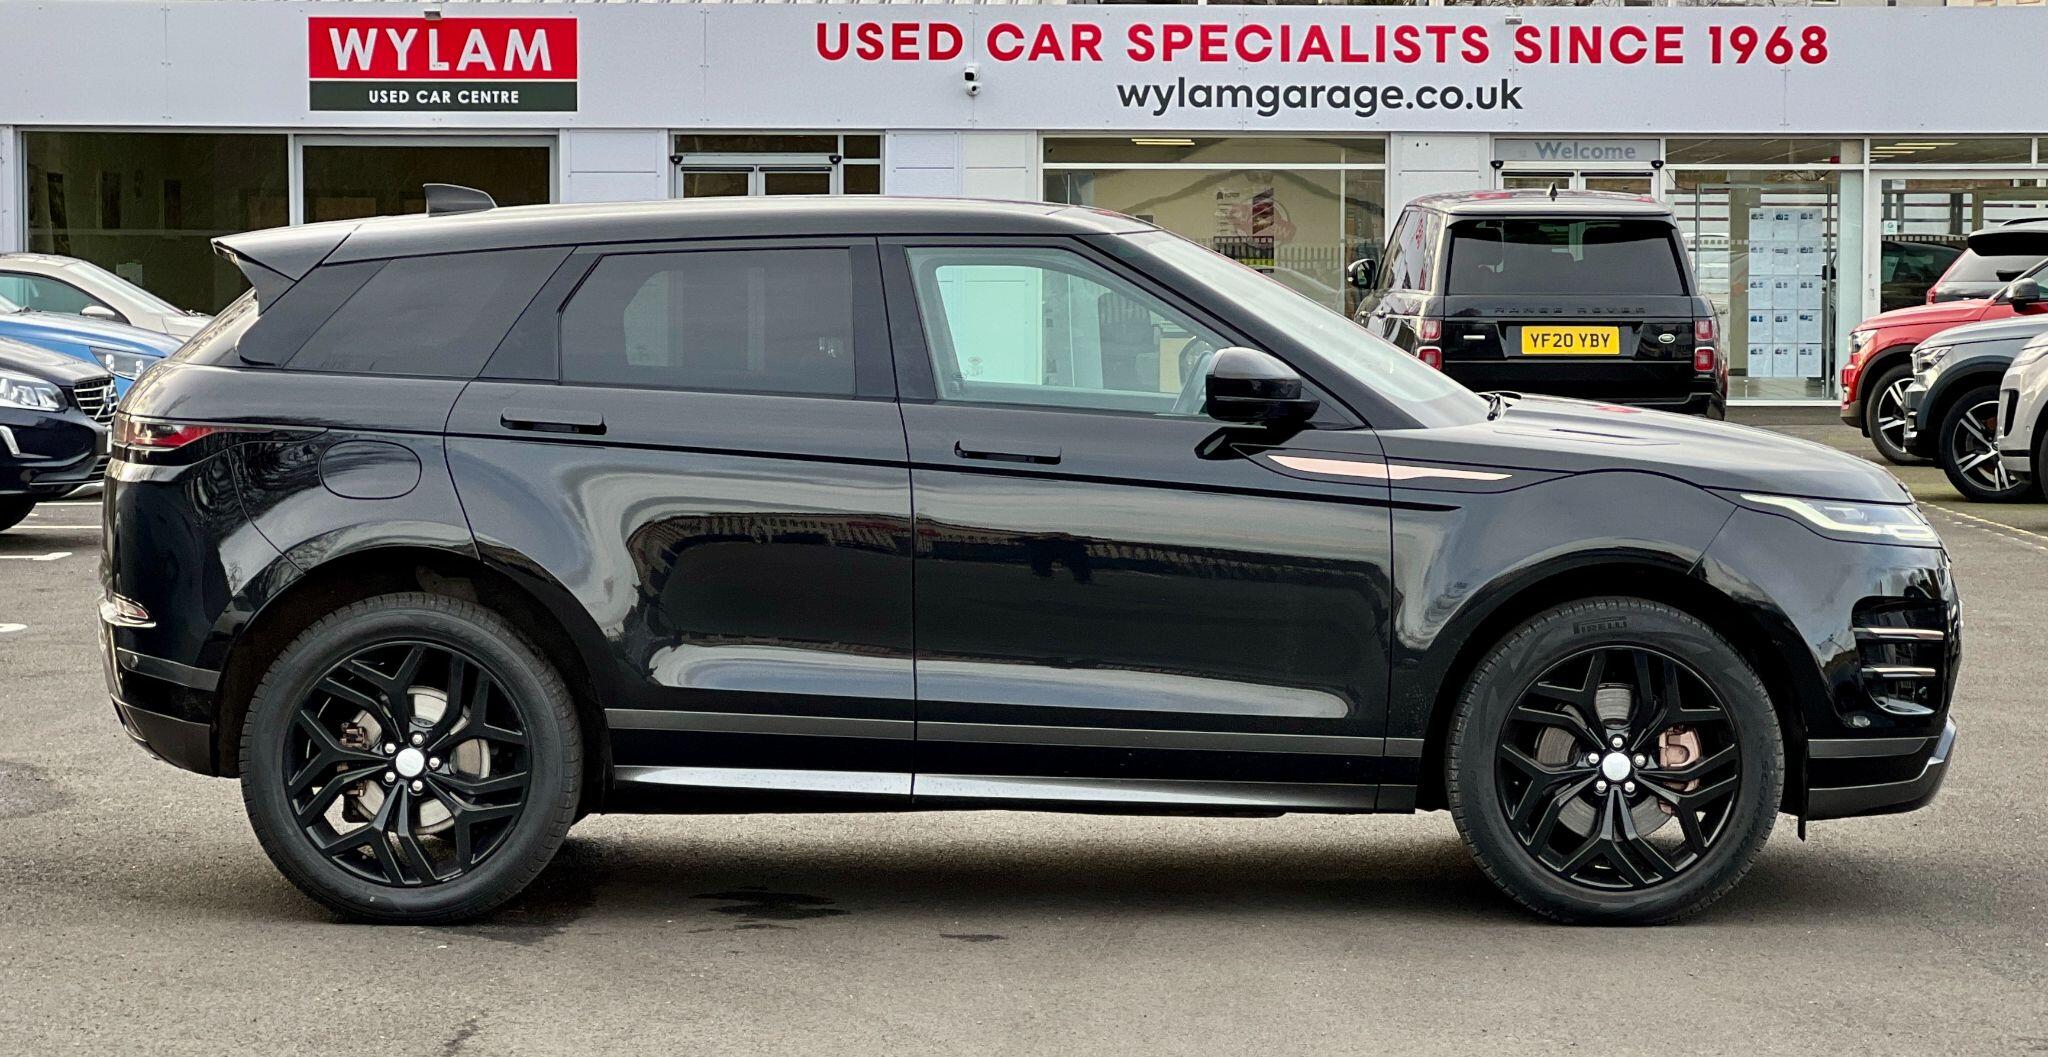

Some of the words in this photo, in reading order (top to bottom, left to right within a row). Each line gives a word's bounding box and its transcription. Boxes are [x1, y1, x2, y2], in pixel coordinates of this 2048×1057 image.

[328, 27, 552, 71] WYLAM
[816, 22, 964, 61] USED
[986, 22, 1103, 62] CAR
[1126, 23, 1490, 64] SPECIALISTS
[1514, 25, 1684, 64] SINCE
[1708, 25, 1828, 65] 1968
[368, 89, 410, 104] USED
[416, 89, 450, 104] CAR
[457, 89, 519, 104] CENTRE
[1117, 76, 1524, 118] wylamgarage.co.uk
[1535, 141, 1636, 160] Welcome
[1530, 333, 1573, 347] YF20
[1579, 333, 1610, 347] YBY
[1573, 615, 1627, 635] PIRELLI
